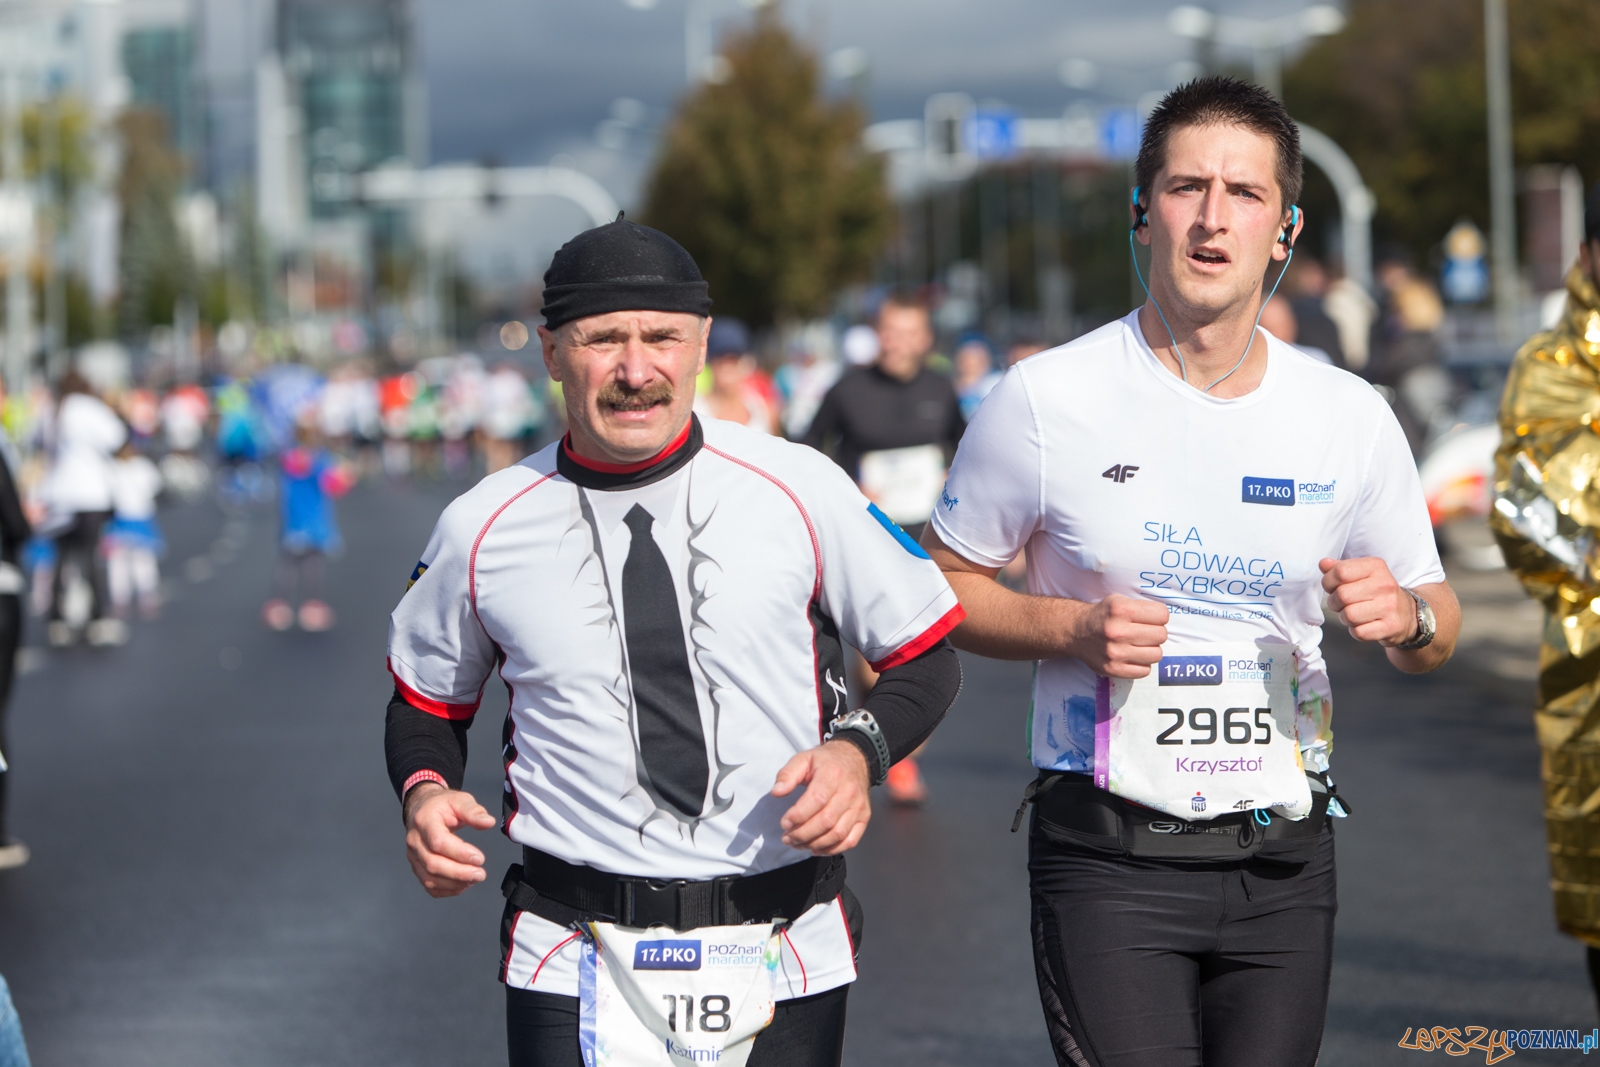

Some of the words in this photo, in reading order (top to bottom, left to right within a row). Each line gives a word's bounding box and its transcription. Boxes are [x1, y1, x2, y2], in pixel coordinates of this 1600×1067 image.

[1102, 463, 1140, 484] 4F
[1300, 492, 1334, 501] maraton
[1143, 521, 1203, 547] SIŁA
[1160, 549, 1285, 580] ODWAGA
[1139, 571, 1282, 598] SZYBKOŚĆ
[1229, 671, 1272, 680] maraton
[1156, 707, 1272, 745] 2965
[1176, 756, 1263, 775] Krzysztof
[662, 947, 697, 963] PKO
[708, 955, 763, 965] maraton
[662, 994, 732, 1032] 118
